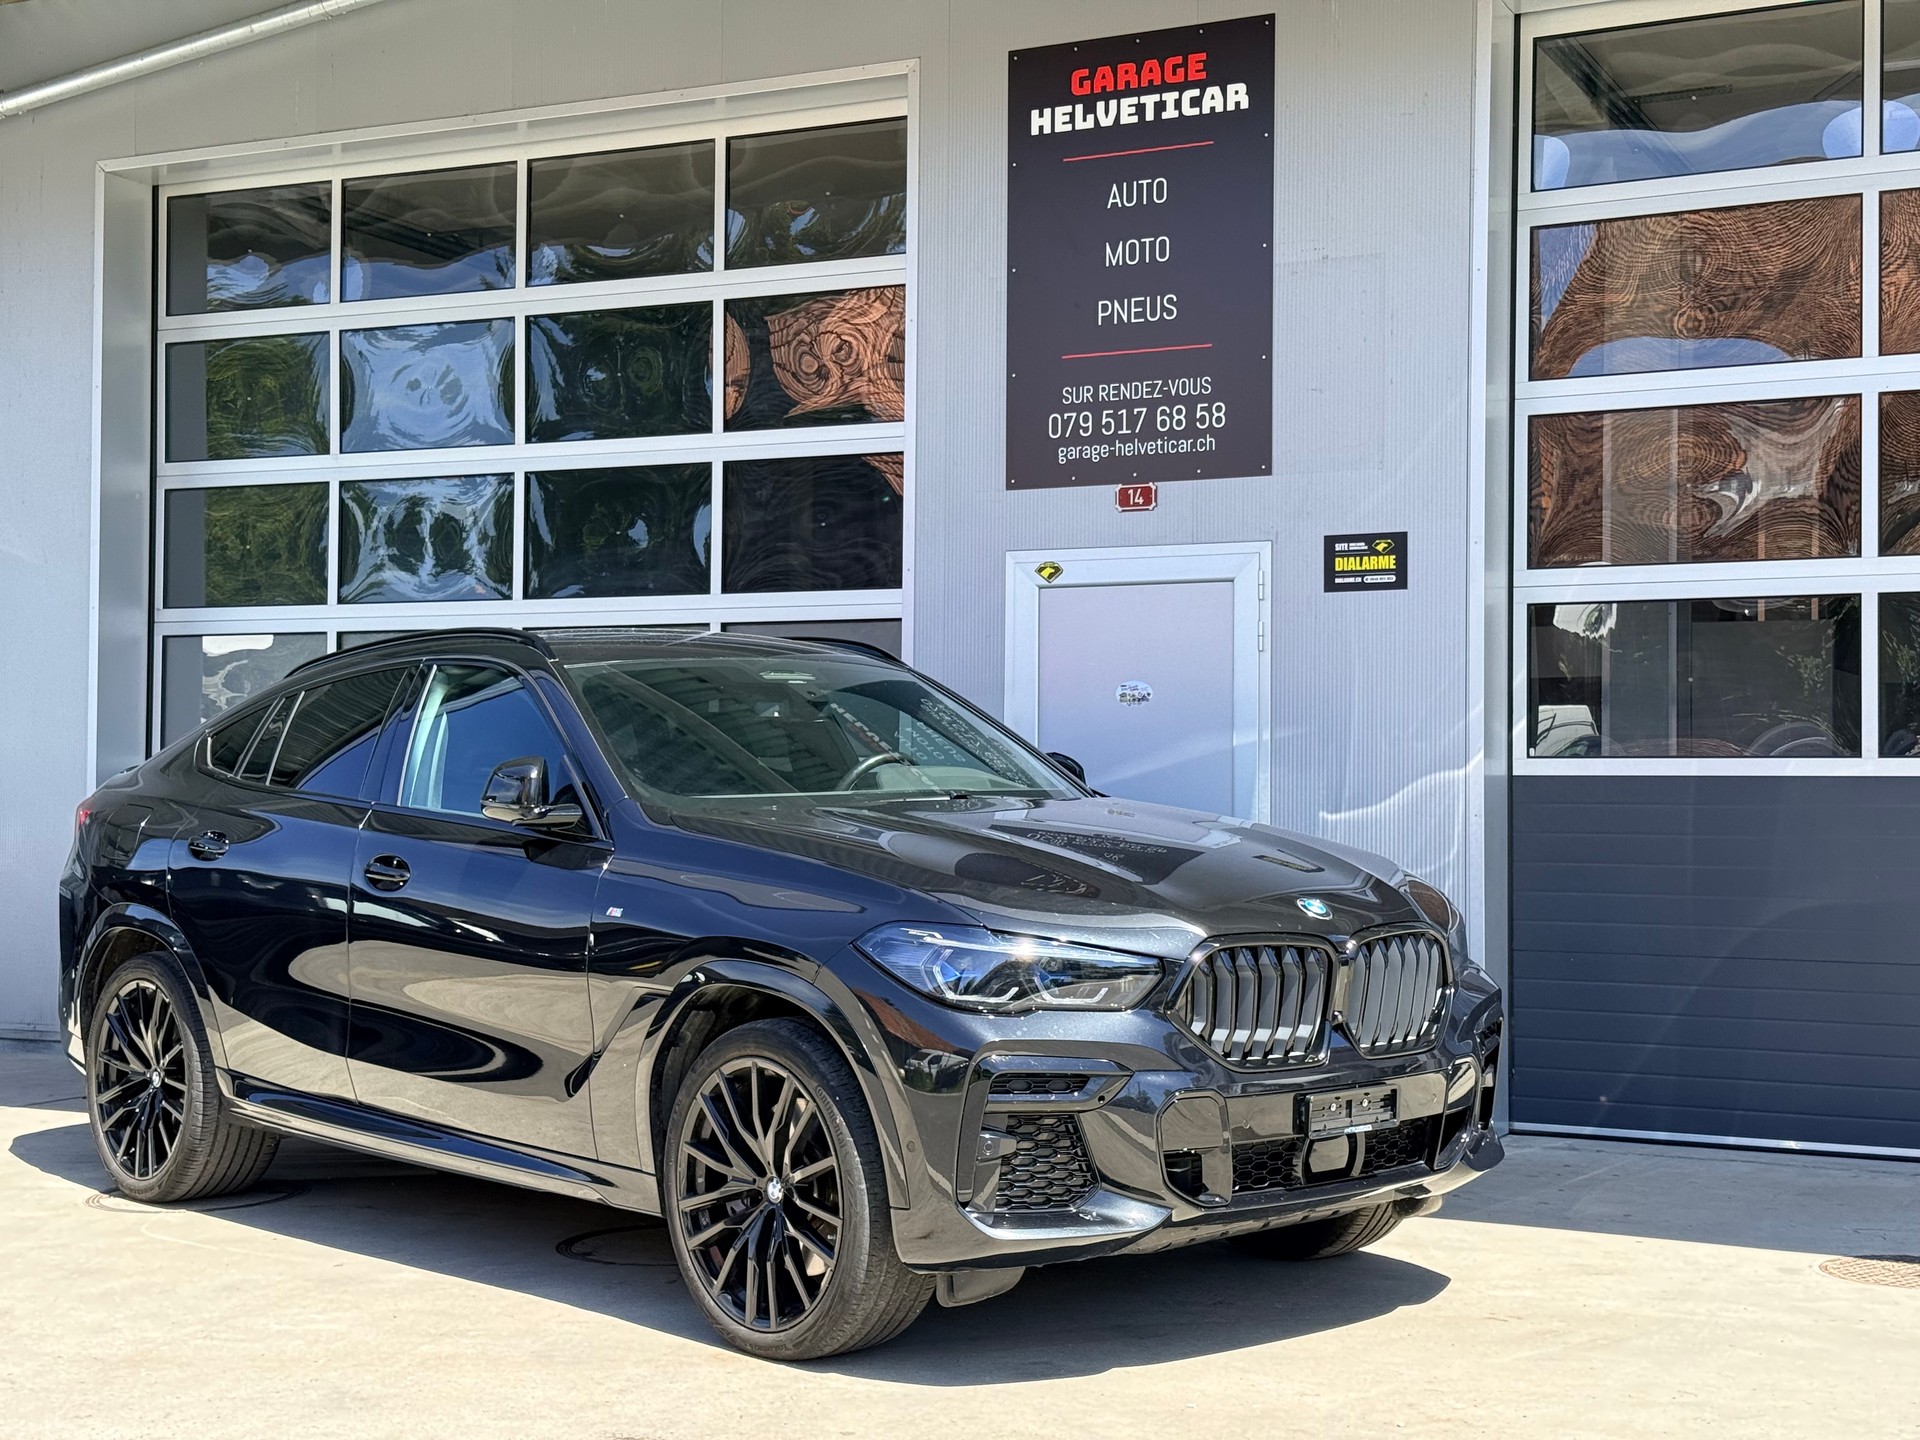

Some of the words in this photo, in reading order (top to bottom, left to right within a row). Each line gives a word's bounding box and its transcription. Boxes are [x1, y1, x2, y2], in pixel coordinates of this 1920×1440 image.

[1070, 52, 1208, 96] GARAGE
[1030, 82, 1250, 136] HELVETICAR
[1107, 177, 1168, 209] AUTO
[1105, 236, 1170, 267] MOTO
[1097, 294, 1178, 326] PNEUS
[1062, 384, 1093, 405] SUR
[1098, 376, 1212, 402] RENDEZ-VOUS
[1048, 411, 1093, 439] 079
[1101, 407, 1148, 436] 517
[1156, 404, 1187, 432] 68
[1195, 401, 1227, 430] 58
[1058, 434, 1216, 464] garage-helveticar.ch
[1127, 488, 1144, 506] 14
[1335, 543, 1348, 551] SITE
[1335, 555, 1397, 571] DIALARME
[815, 1085, 846, 1149] Continental
